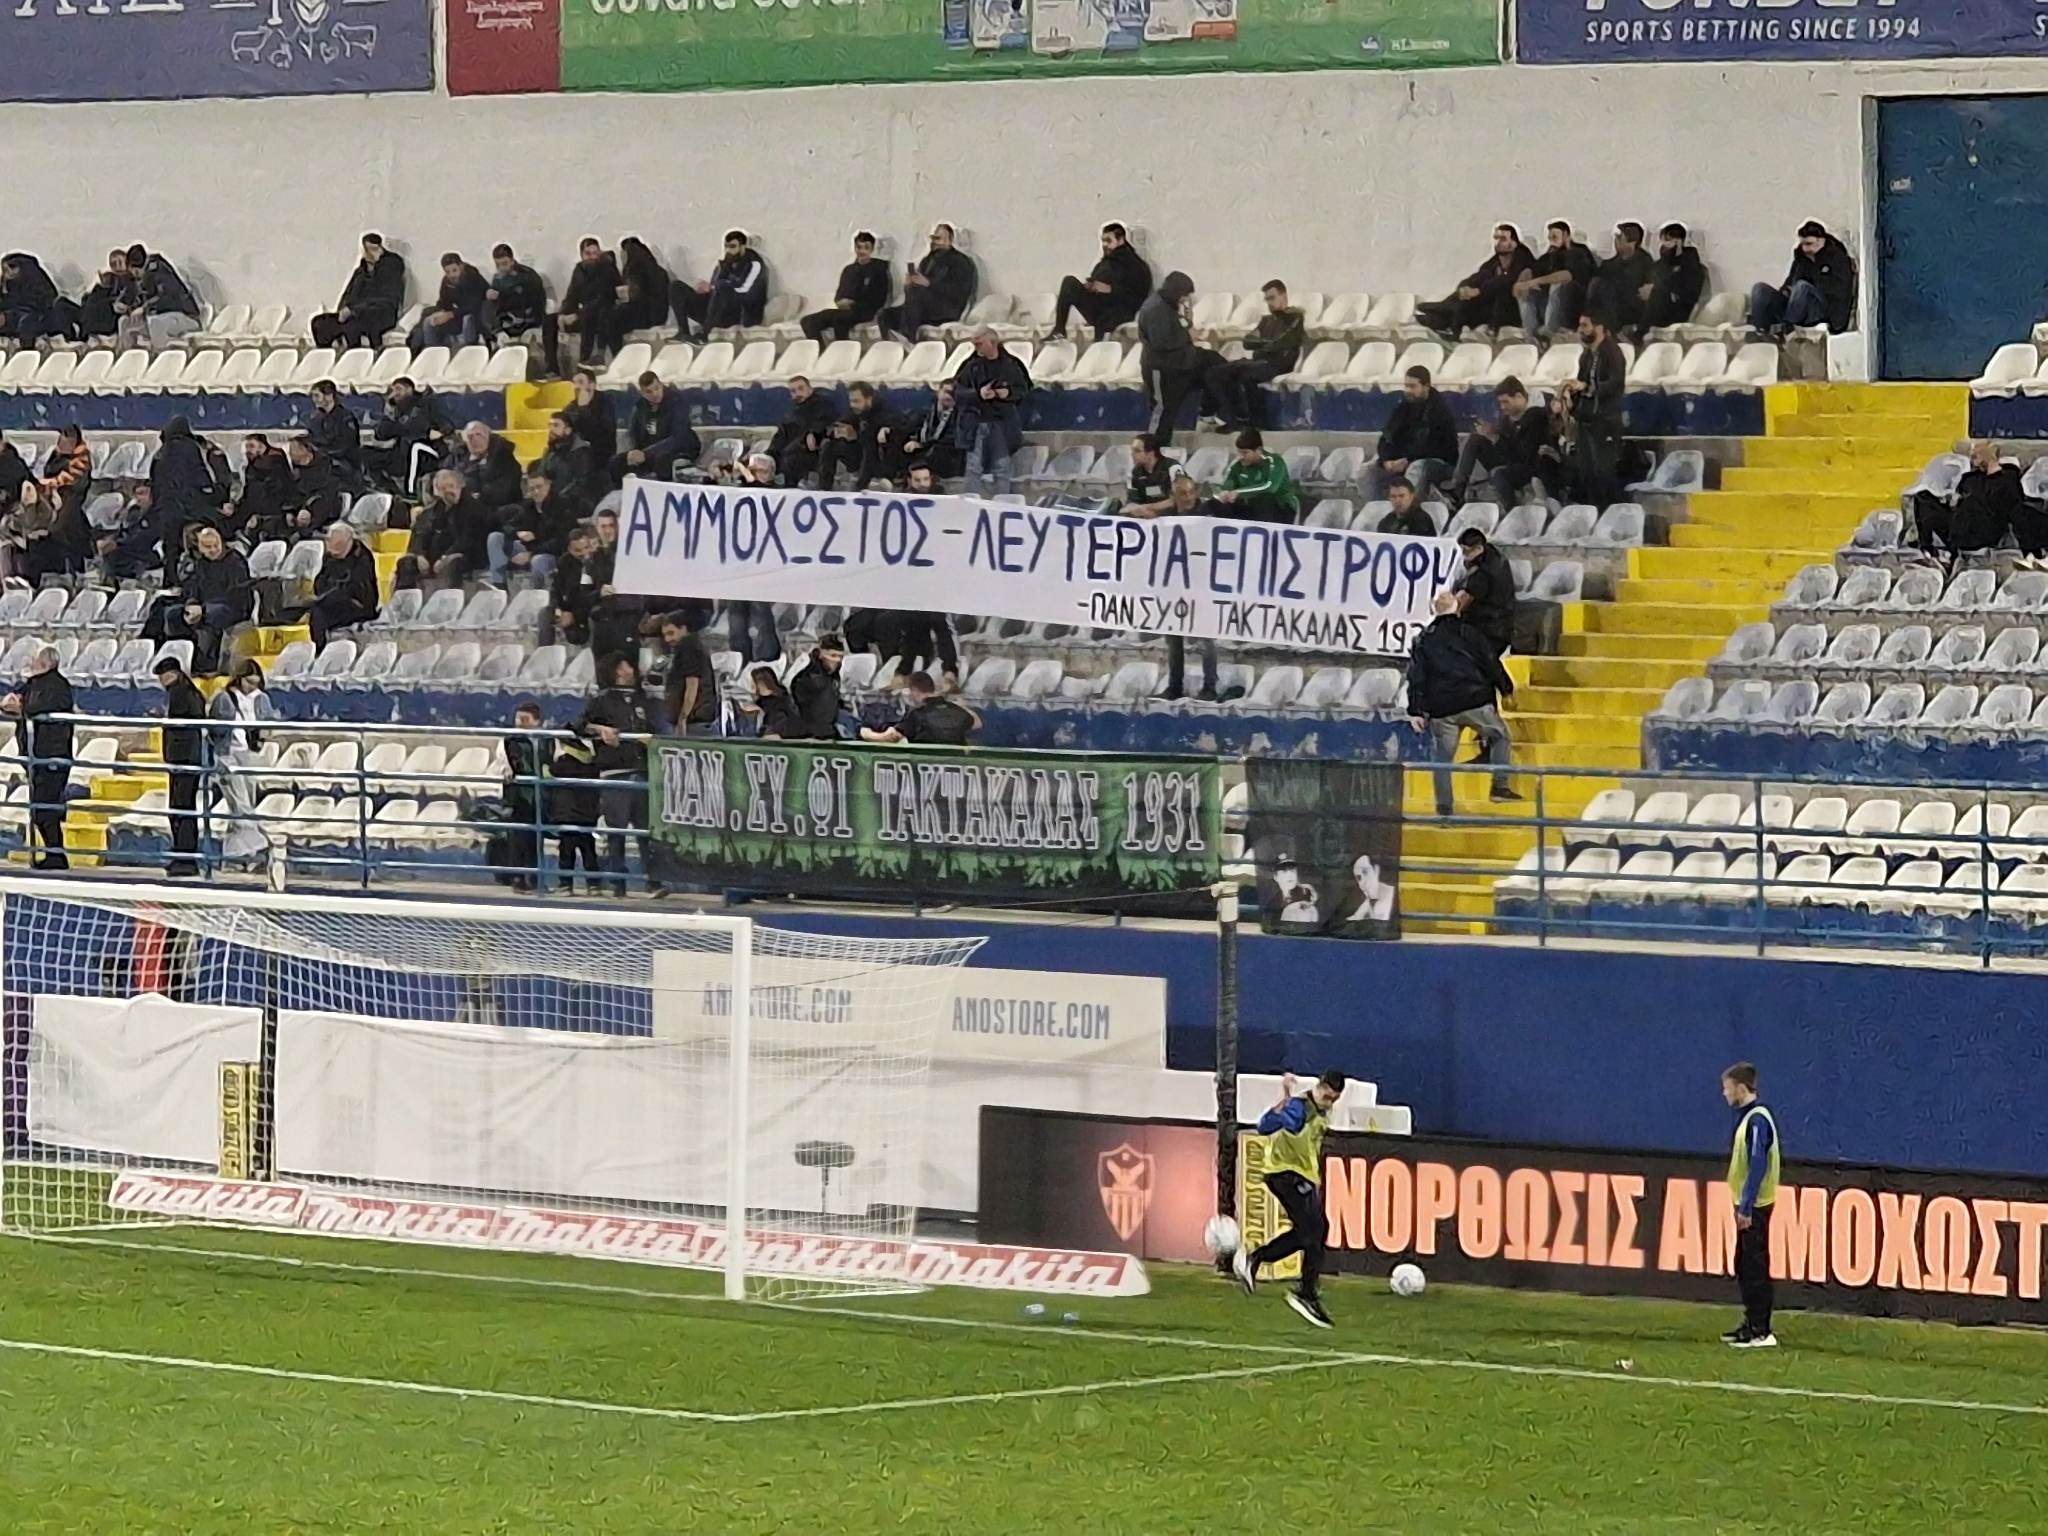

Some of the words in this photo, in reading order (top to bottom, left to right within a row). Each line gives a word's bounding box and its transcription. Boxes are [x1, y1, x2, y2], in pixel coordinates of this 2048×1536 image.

[1586, 19, 1673, 43] SPORTS
[1682, 18, 1780, 41] BETTING
[1788, 17, 1858, 40] SINCE
[1867, 16, 1921, 39] 1994
[1213, 600, 1369, 651] ΤΑΚΤΑΚΑΛΑΣ
[874, 761, 1099, 850] ΤΑΚΤΑΚΑΛΑΣ
[1121, 771, 1205, 852] 1931
[952, 996, 1110, 1040] ANOSTORE.COM
[114, 1175, 297, 1219] makita
[1325, 1156, 1646, 1268] ΝΟΡΘΩΣΙΣ
[305, 1200, 490, 1241] makita
[500, 1208, 693, 1261] makita
[909, 1244, 1120, 1289] makita
